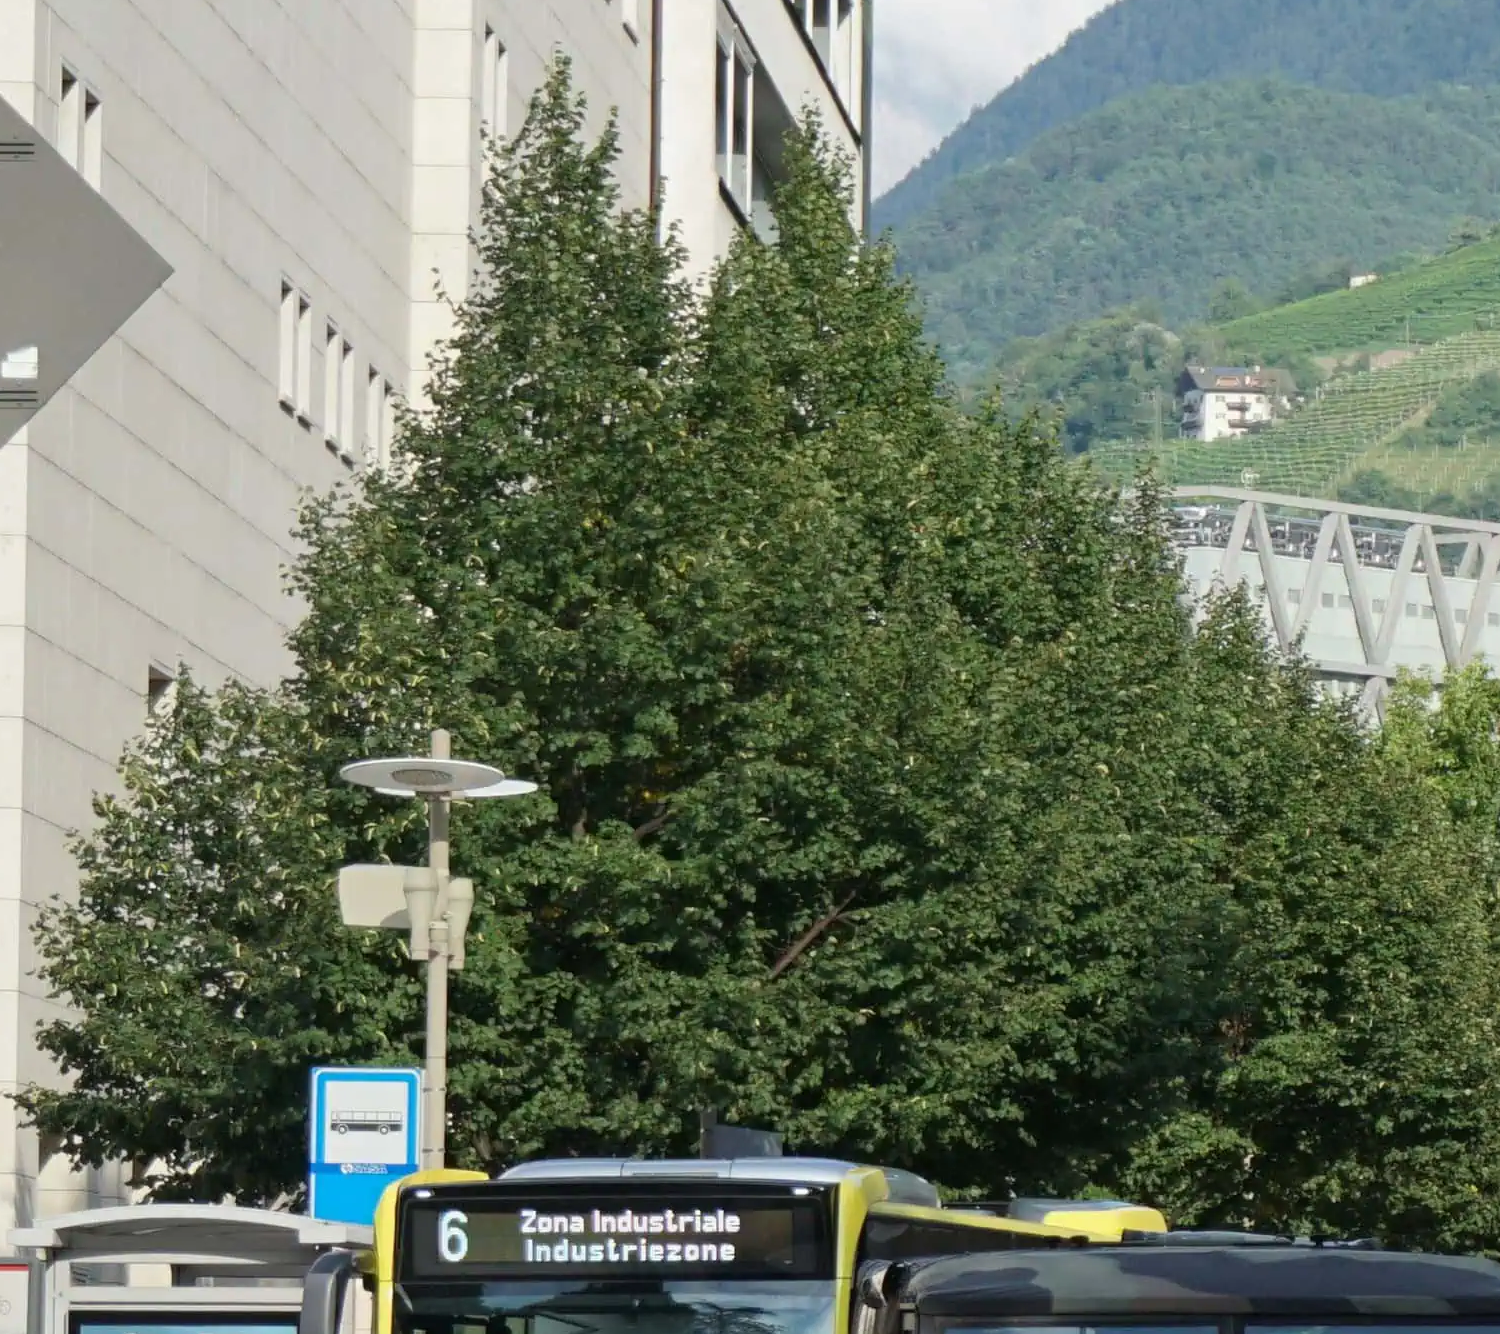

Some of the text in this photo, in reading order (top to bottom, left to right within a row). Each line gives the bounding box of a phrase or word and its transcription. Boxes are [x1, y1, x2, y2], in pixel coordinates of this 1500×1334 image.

[439, 1210, 741, 1263] 6 Zona Industriale
[523, 1238, 736, 1262] Industriezone
